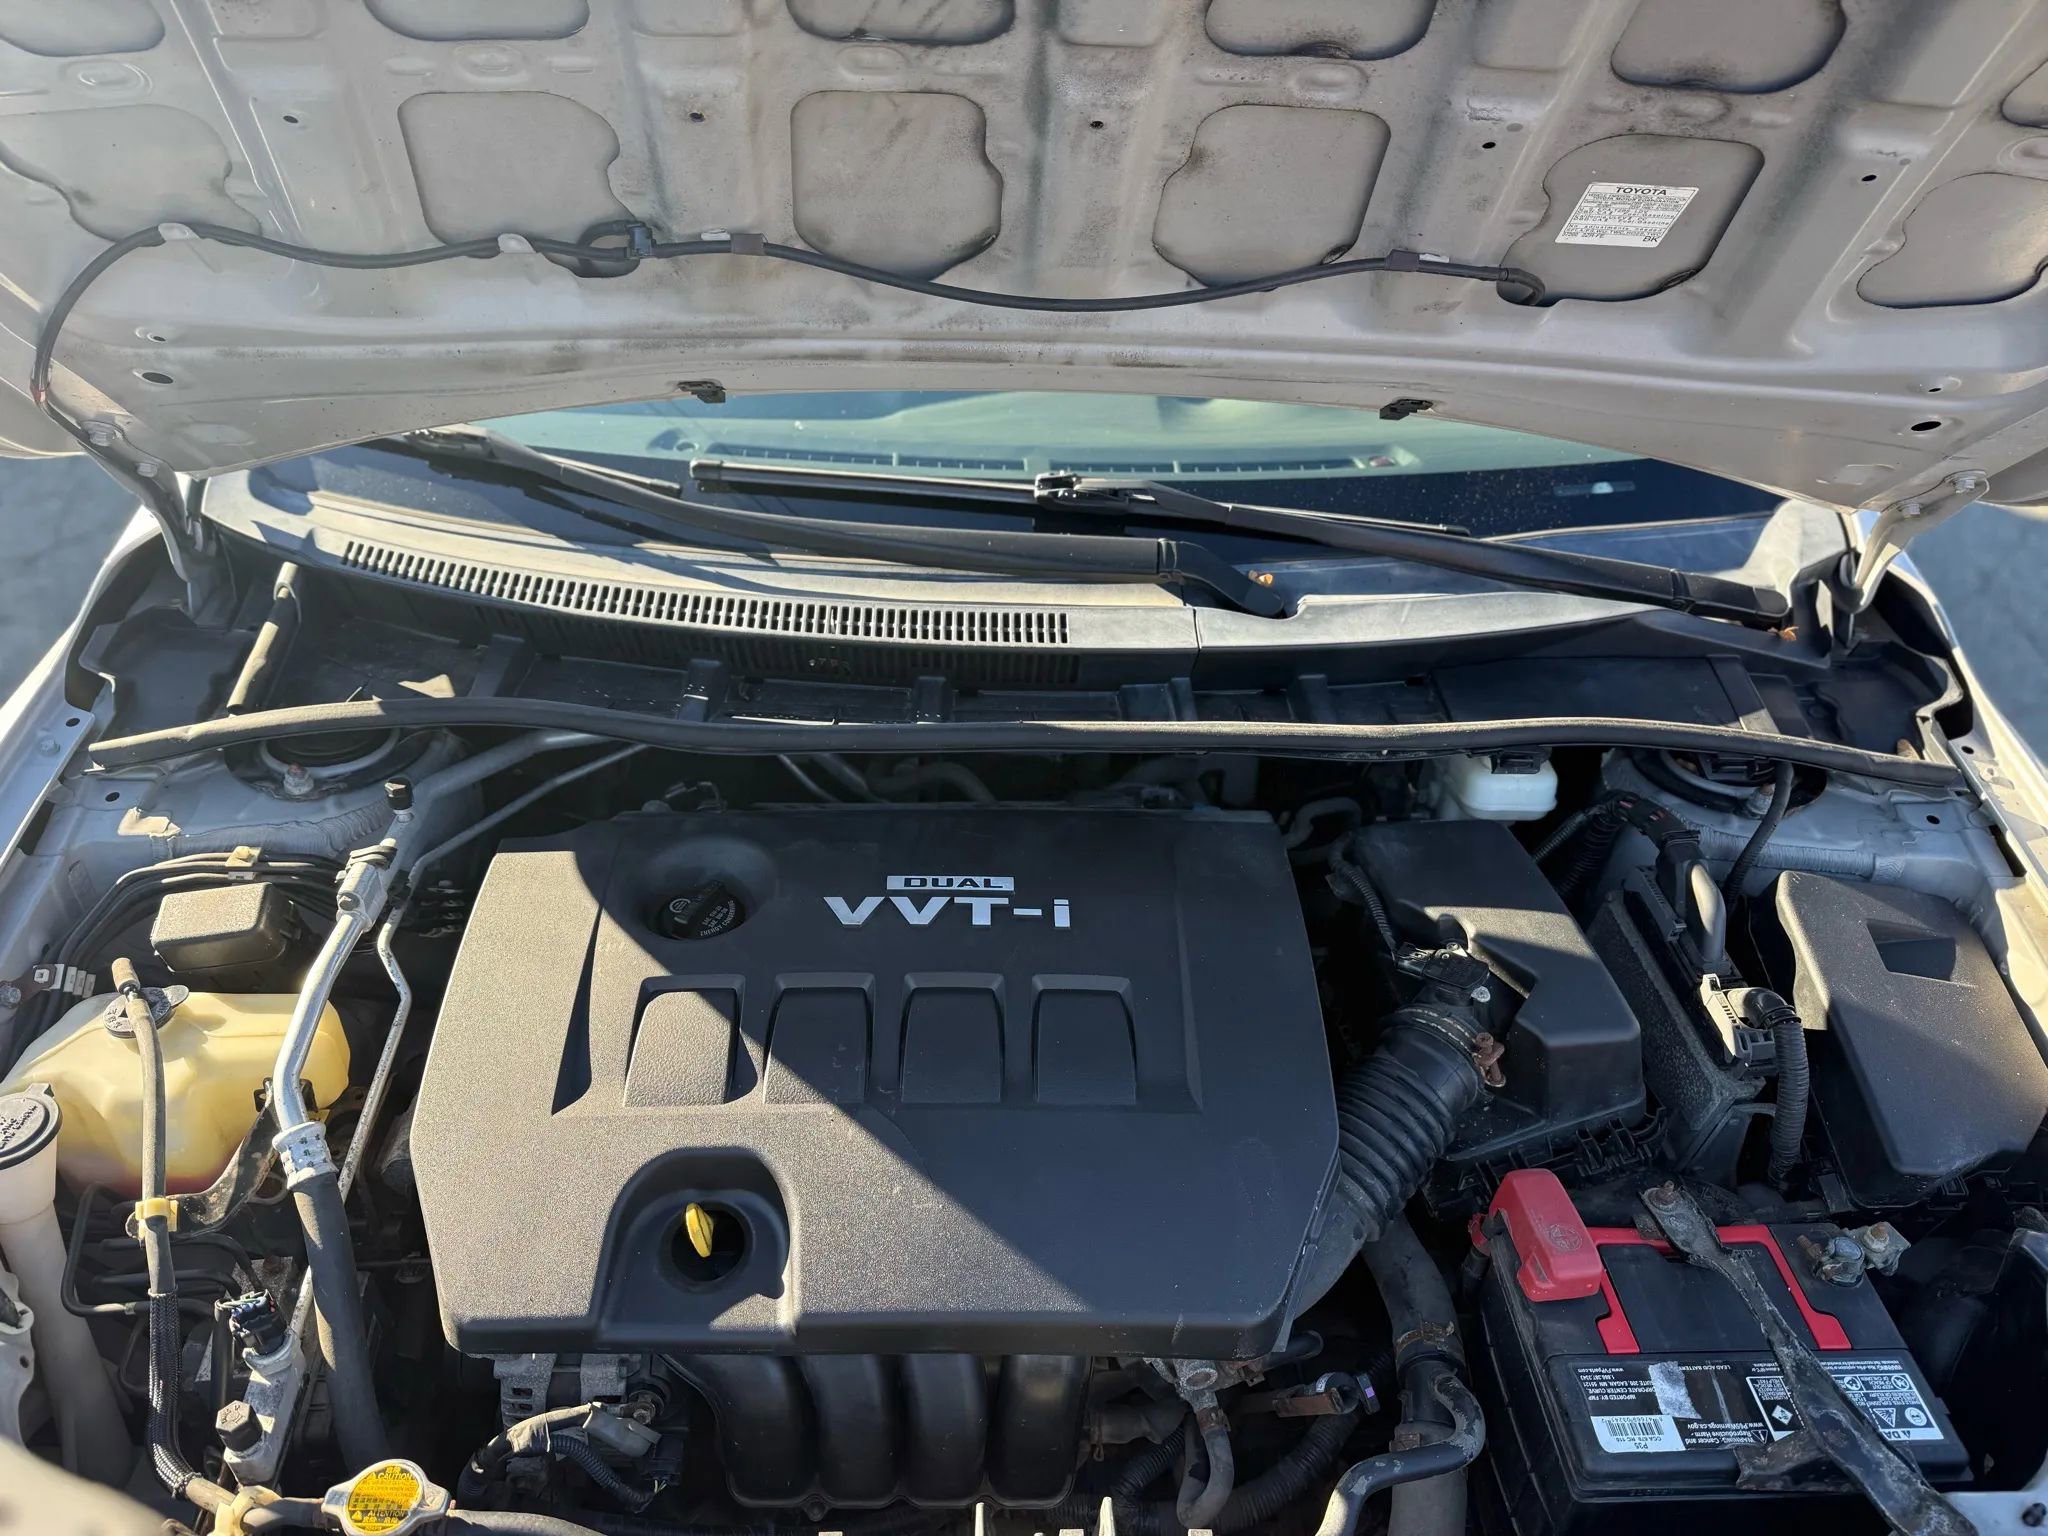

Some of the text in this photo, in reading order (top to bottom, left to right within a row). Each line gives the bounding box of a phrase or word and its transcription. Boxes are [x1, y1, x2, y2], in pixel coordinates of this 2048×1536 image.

[1616, 187, 1667, 196] TOYOTA
[903, 877, 1005, 889] DUAL
[823, 896, 1071, 927] VVT-i
[700, 923, 723, 937] ENERGY
[1687, 1421, 1764, 1430] www.P65Warnings.ca.gov
[378, 1472, 413, 1480] CAUTION
